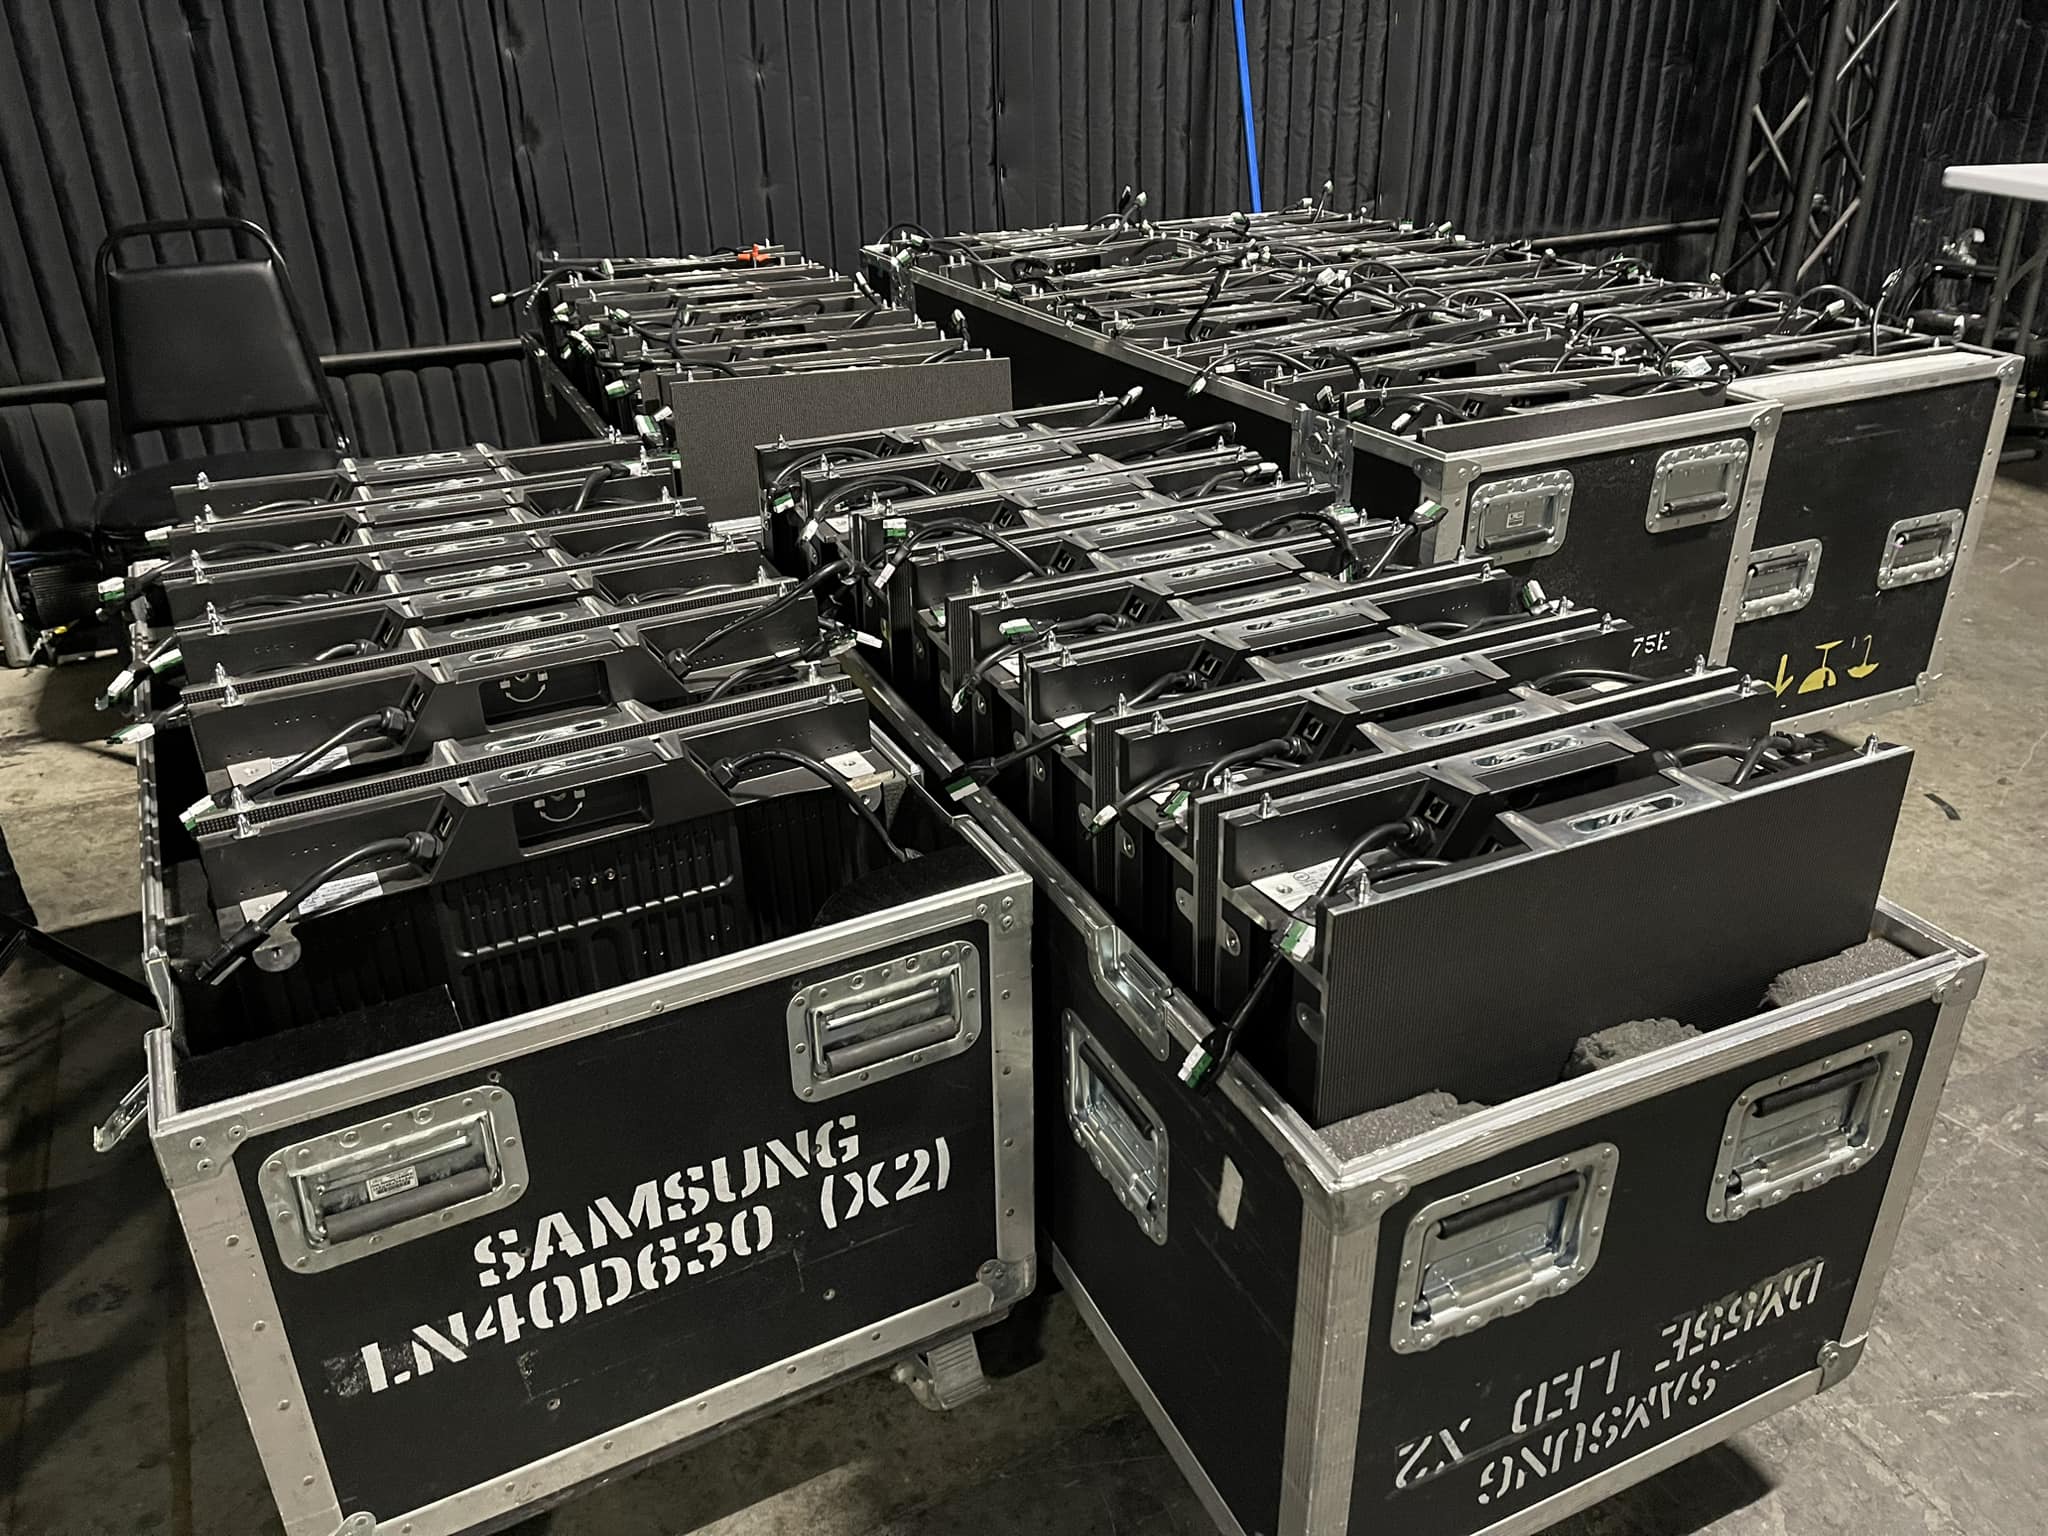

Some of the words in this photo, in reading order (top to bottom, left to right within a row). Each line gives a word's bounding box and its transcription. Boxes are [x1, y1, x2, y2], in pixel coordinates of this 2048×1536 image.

[360, 1205, 774, 1394] LN40D630
[820, 1137, 951, 1229] (X2)
[473, 1114, 859, 1288] SAMSUNG
[1395, 1417, 1472, 1489] X2
[1477, 1359, 1721, 1505] SAMSUNG
[1512, 1349, 1621, 1435] LED
